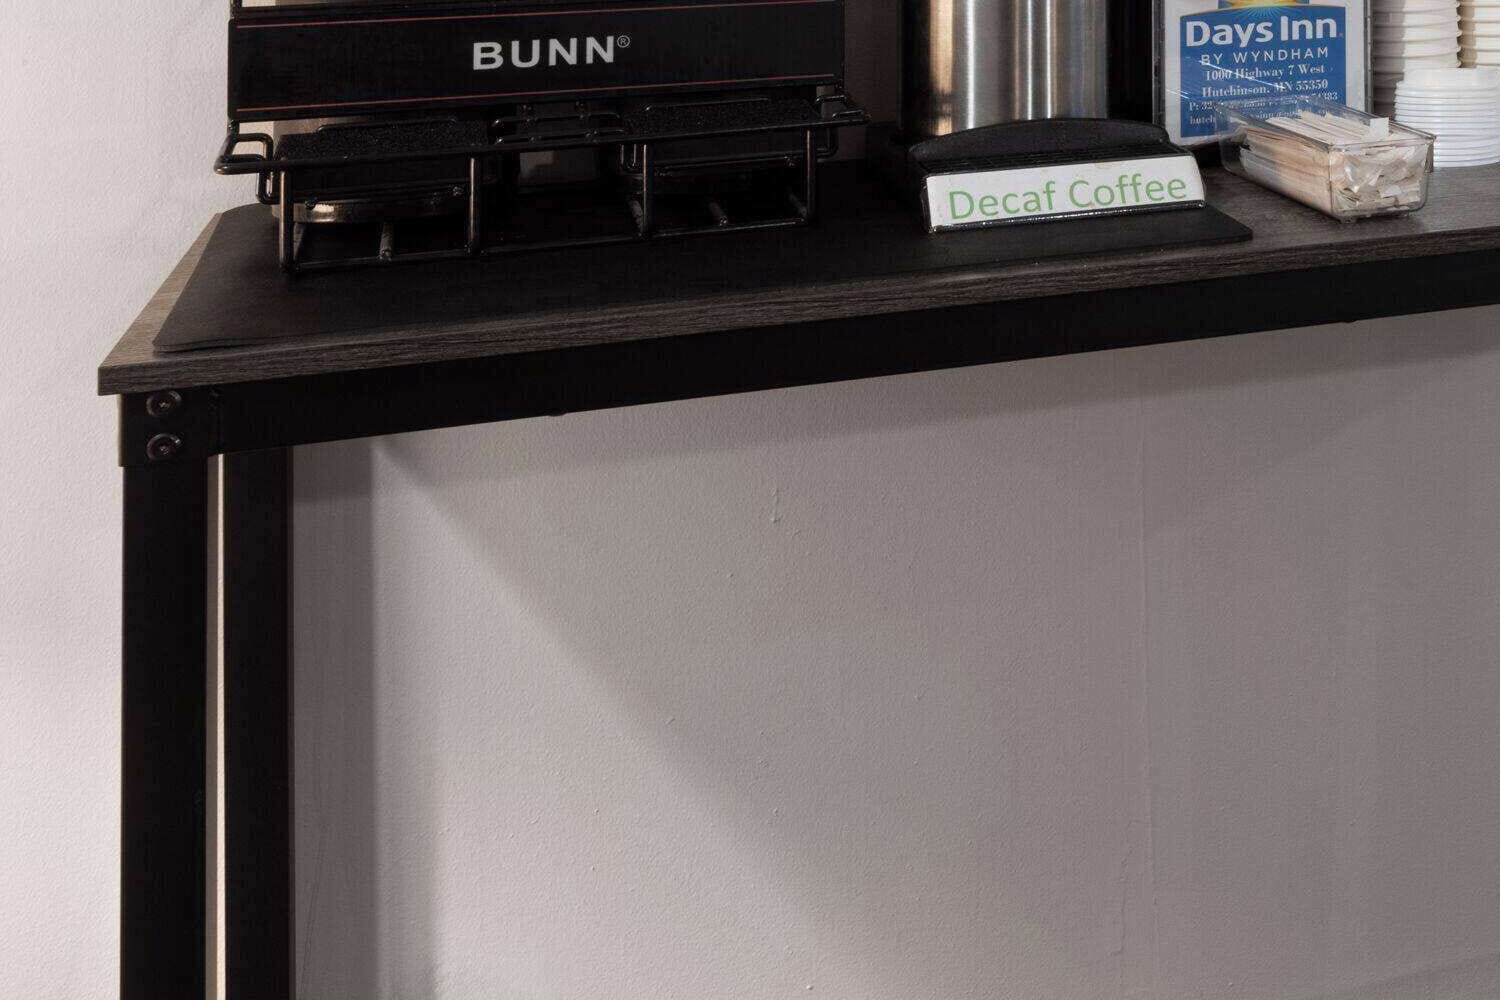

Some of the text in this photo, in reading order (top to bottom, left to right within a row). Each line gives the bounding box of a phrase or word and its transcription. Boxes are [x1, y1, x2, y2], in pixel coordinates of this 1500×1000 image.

[1185, 15, 1337, 48] Days Inn
[1201, 46, 1329, 66] BY WYNDHAM
[1206, 63, 1325, 81] 1000 Highway 7 West
[1295, 78, 1329, 91] 55350
[949, 172, 1188, 220] Decaf Coffee
